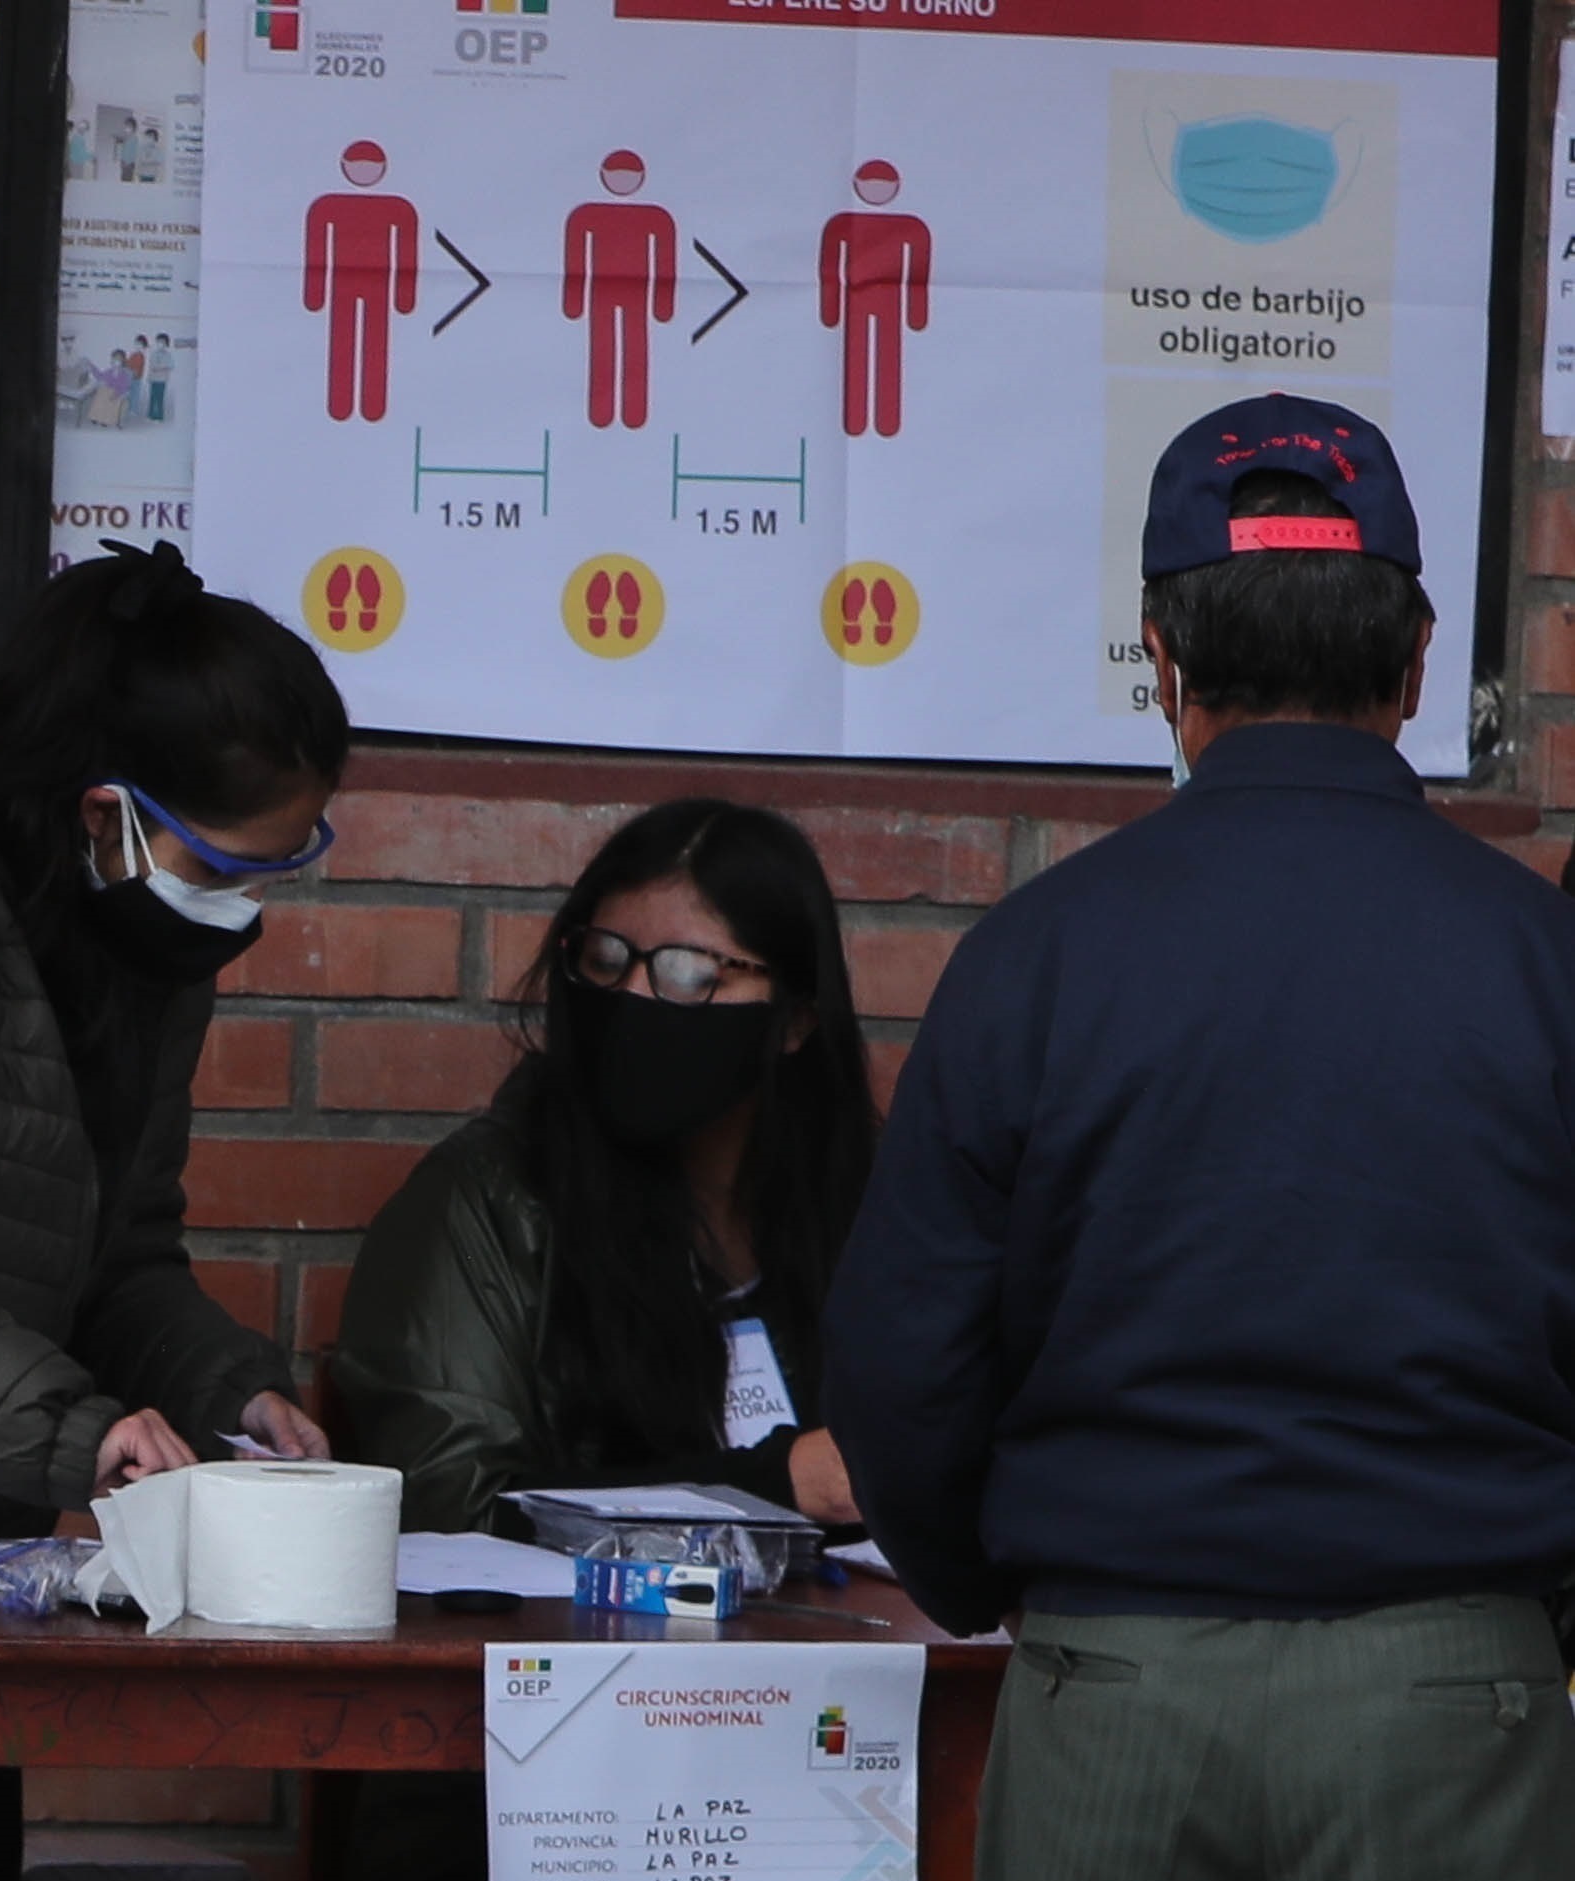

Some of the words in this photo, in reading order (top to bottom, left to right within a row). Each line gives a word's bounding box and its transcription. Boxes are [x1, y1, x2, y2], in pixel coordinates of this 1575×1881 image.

[454, 28, 550, 65] OEP
[314, 54, 386, 79] 2020
[1130, 286, 1191, 309] uso
[1201, 284, 1242, 312] de
[1252, 285, 1366, 323] barbijo
[1159, 325, 1337, 363] obligatorio
[51, 503, 130, 529] VOTO
[439, 501, 484, 528] 1.5
[495, 502, 521, 529] M
[696, 508, 740, 535] 1.5
[752, 509, 778, 536] M
[1109, 642, 1155, 665] us
[507, 1679, 552, 1698] OEP
[615, 1686, 792, 1707] CIRCUNSCRIPCIÓN
[643, 1711, 765, 1728] UNINOMINAL
[854, 1756, 901, 1772] 2020
[498, 1810, 619, 1827] DEPARTAMENTO:
[656, 1803, 686, 1822] LA
[706, 1799, 752, 1818] PAZ
[533, 1835, 619, 1849] PROVINCIA:
[530, 1860, 618, 1875] MUNICIPIO:
[646, 1853, 676, 1872] LA
[691, 1850, 740, 1868] PAZ
